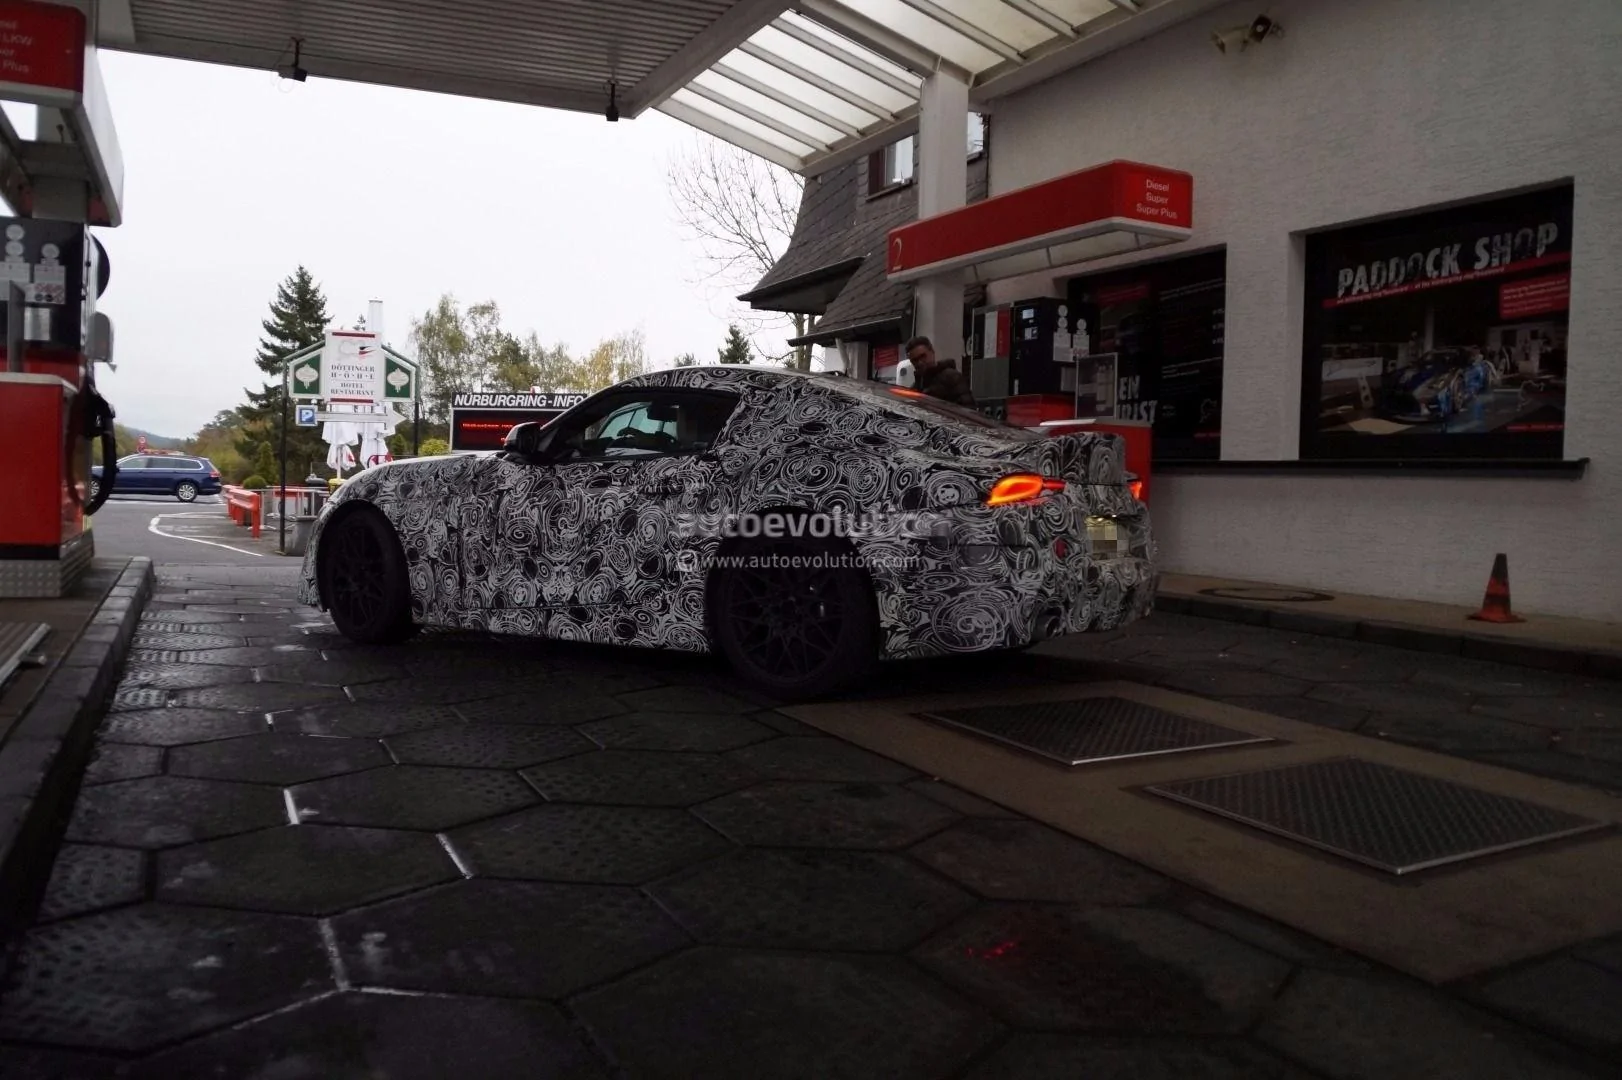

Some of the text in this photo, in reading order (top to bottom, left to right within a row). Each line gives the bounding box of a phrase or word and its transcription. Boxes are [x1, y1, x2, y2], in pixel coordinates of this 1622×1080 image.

[1146, 178, 1170, 192] Diesel
[1145, 191, 1169, 204] Super
[1136, 202, 1178, 220] Super Plus
[892, 237, 903, 271] 2
[1337, 244, 1463, 298] PADDOCK
[1474, 221, 1559, 270] SHOP
[330, 388, 375, 396] RESTAURANT
